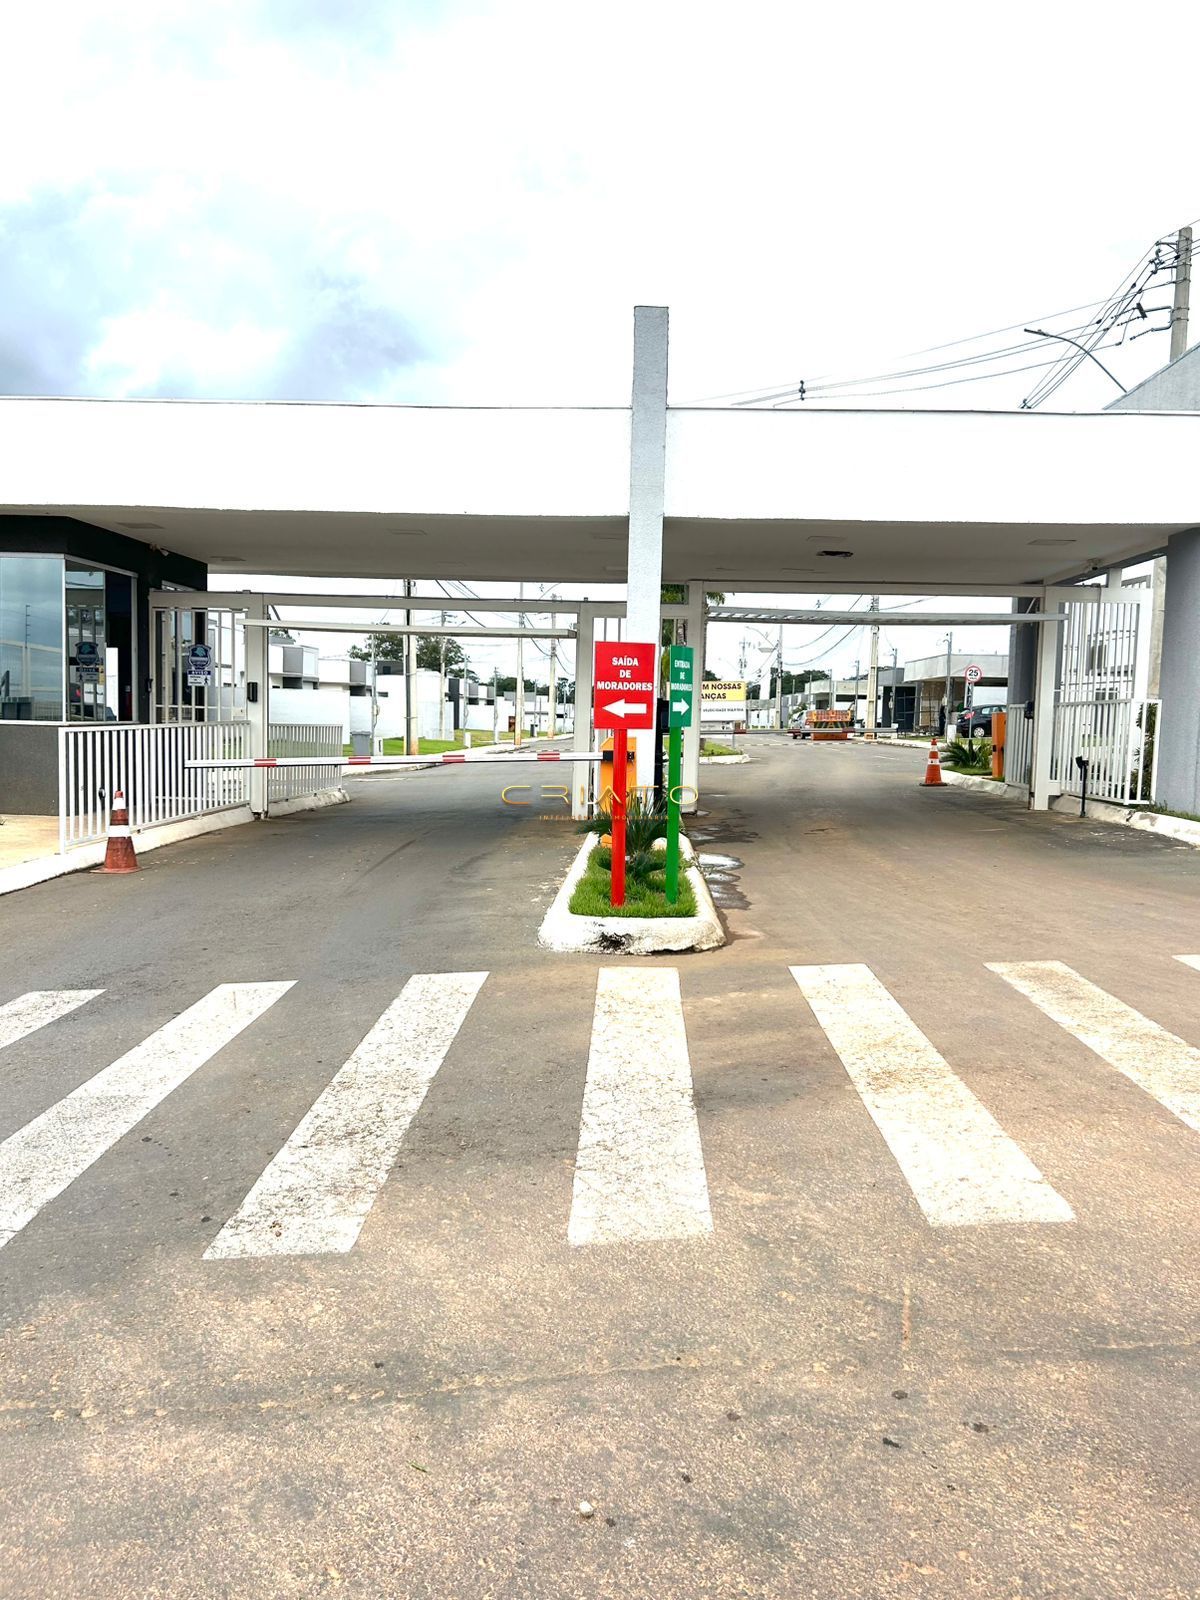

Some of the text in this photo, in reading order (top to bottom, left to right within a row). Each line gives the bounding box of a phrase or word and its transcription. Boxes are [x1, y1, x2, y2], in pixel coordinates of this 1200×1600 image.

[612, 655, 639, 666] SAÍDA
[619, 670, 631, 678] DE
[597, 681, 652, 691] MORADORES
[701, 692, 727, 700] ANÇAS
